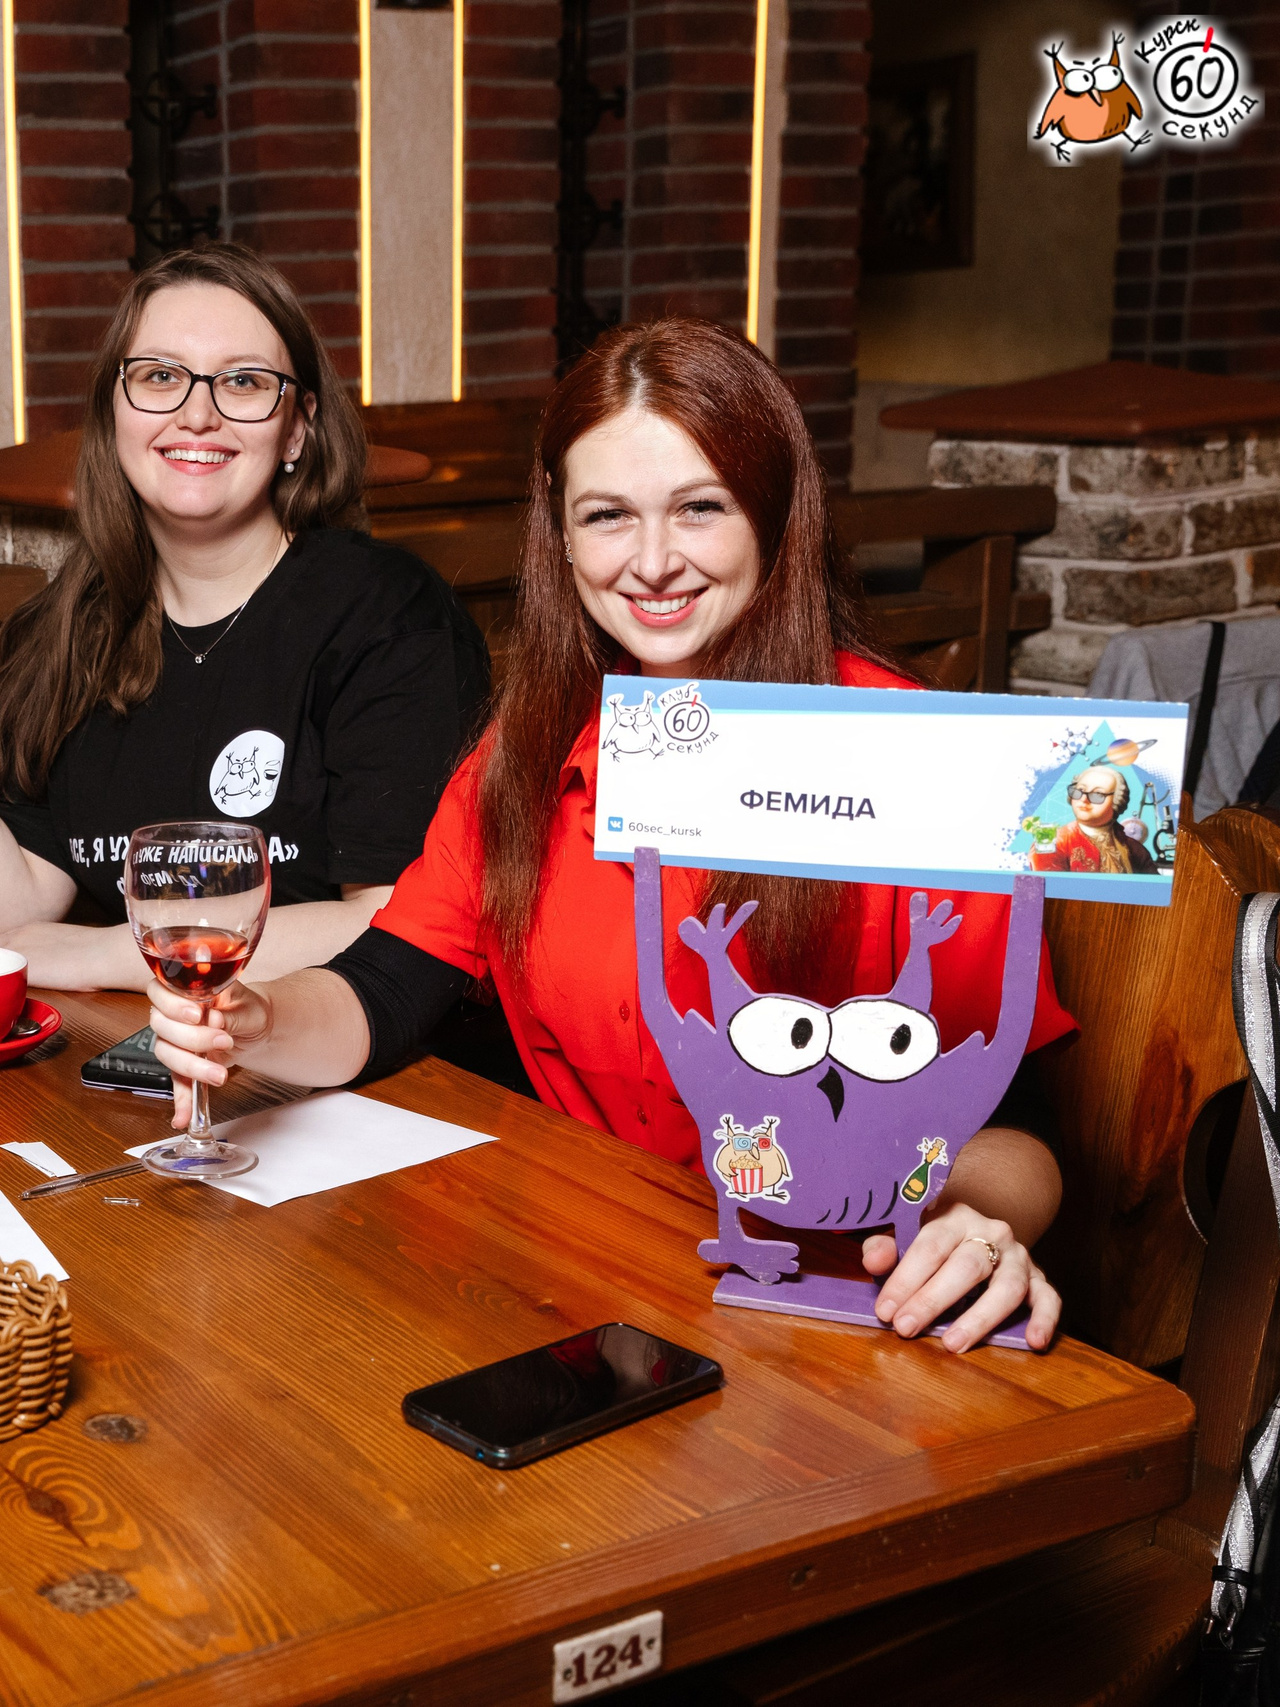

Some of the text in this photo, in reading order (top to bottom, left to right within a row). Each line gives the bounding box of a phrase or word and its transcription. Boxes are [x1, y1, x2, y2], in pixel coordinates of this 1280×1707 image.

[673, 708, 703, 733] 60
[739, 789, 877, 821] ФЕМИДА
[628, 821, 703, 838] 60sec_kursk
[93, 837, 105, 863] Я
[572, 1634, 644, 1689] 124
